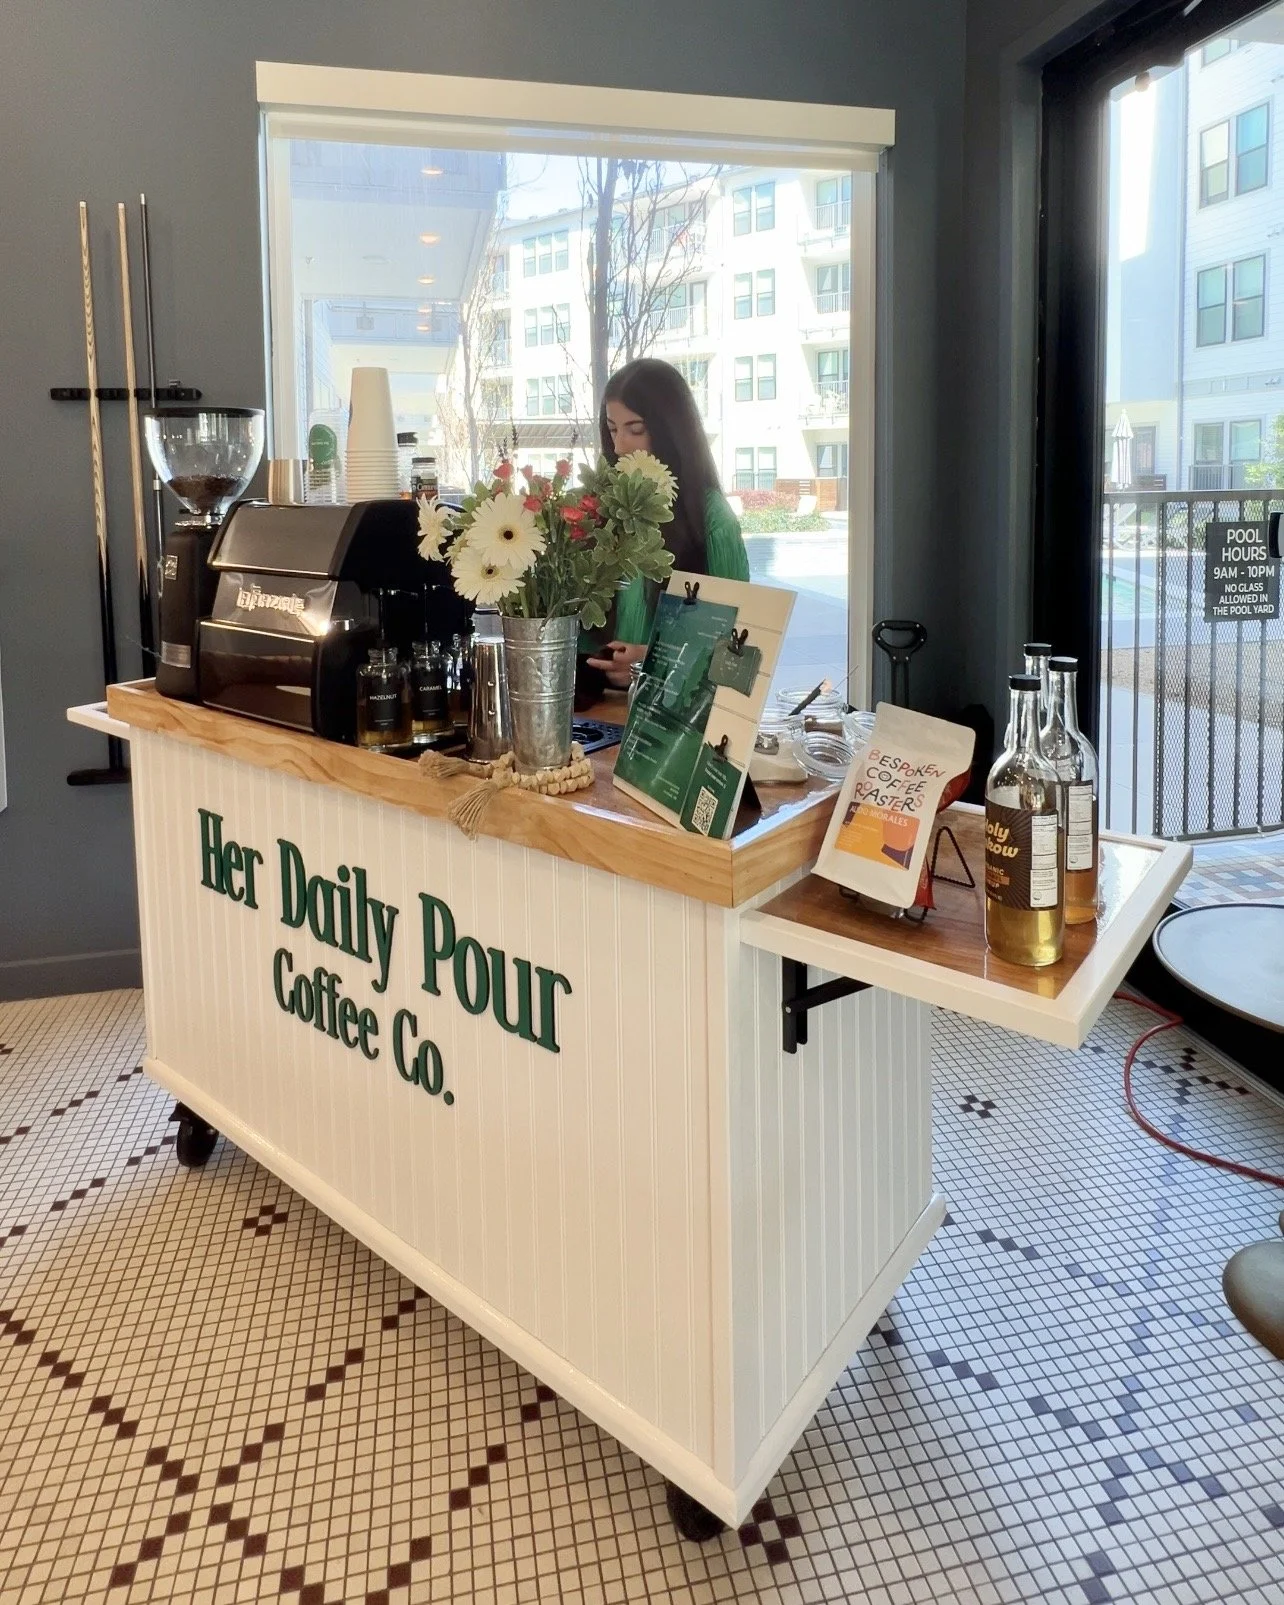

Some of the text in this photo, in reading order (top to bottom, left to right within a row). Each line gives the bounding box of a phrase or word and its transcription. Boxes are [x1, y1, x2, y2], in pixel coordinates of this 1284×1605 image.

[1226, 529, 1263, 544] POOL
[1222, 546, 1267, 561] HOURS
[1213, 567, 1238, 579] 9AM
[1247, 565, 1275, 577] 10PM
[1225, 583, 1264, 592] NO GLASS
[1219, 594, 1268, 604] ALLOWED IN
[1213, 604, 1275, 615] THE POOL YARD
[868, 749, 946, 778] BESPOKEN
[866, 766, 927, 795] COFFEE
[854, 781, 925, 812] ROASTERS
[869, 809, 908, 827] MORALES
[986, 819, 1009, 842] oly
[986, 836, 1019, 858] kow
[198, 808, 572, 1053] Her Daily Pour
[273, 948, 455, 1105] Coffee Co.
